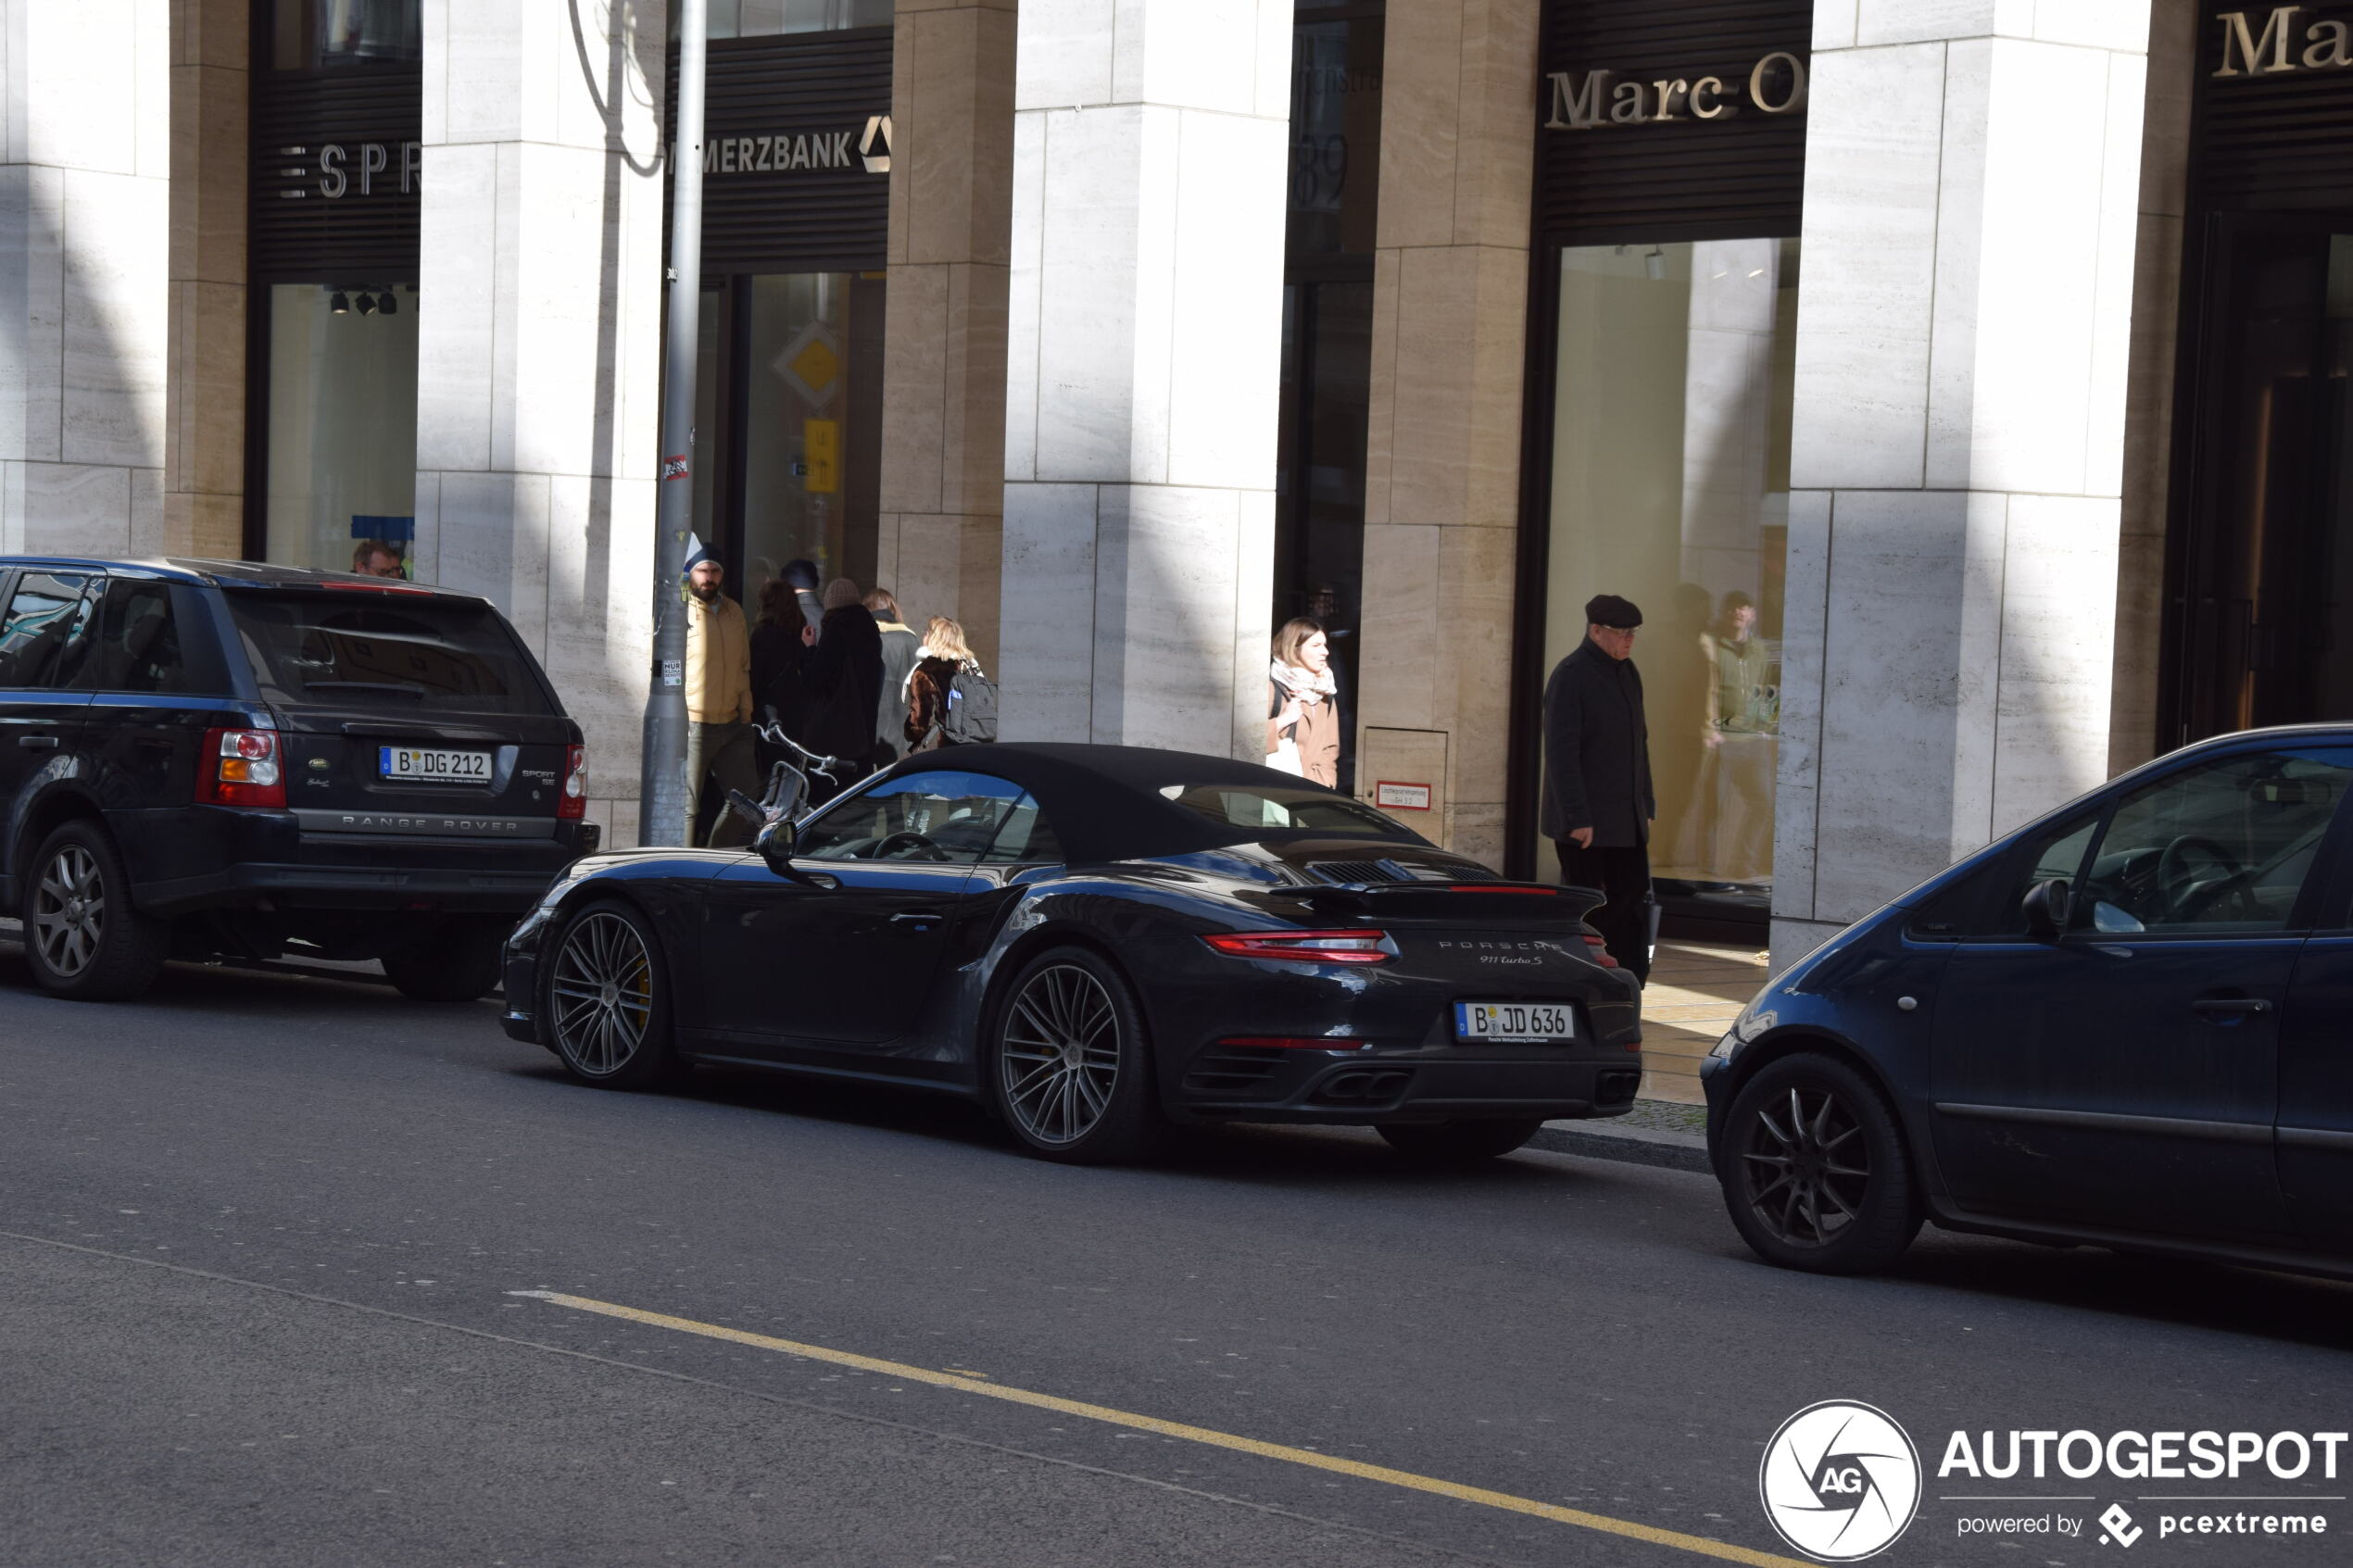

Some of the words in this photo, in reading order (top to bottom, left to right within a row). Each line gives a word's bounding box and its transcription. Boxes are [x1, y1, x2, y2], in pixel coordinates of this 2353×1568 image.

[2212, 6, 2353, 77] Ma
[1544, 69, 1740, 129] Marc
[399, 751, 410, 771] B
[424, 753, 447, 772] DG
[451, 754, 484, 775] 212
[342, 816, 426, 829] RANGE
[444, 821, 518, 831] ROVER
[1439, 941, 1563, 951] PORSCHE
[1479, 955, 1499, 963] 911
[1531, 957, 1543, 965] S
[1475, 1007, 1489, 1034] B
[1502, 1007, 1527, 1034] JD
[1531, 1008, 1566, 1034] 636
